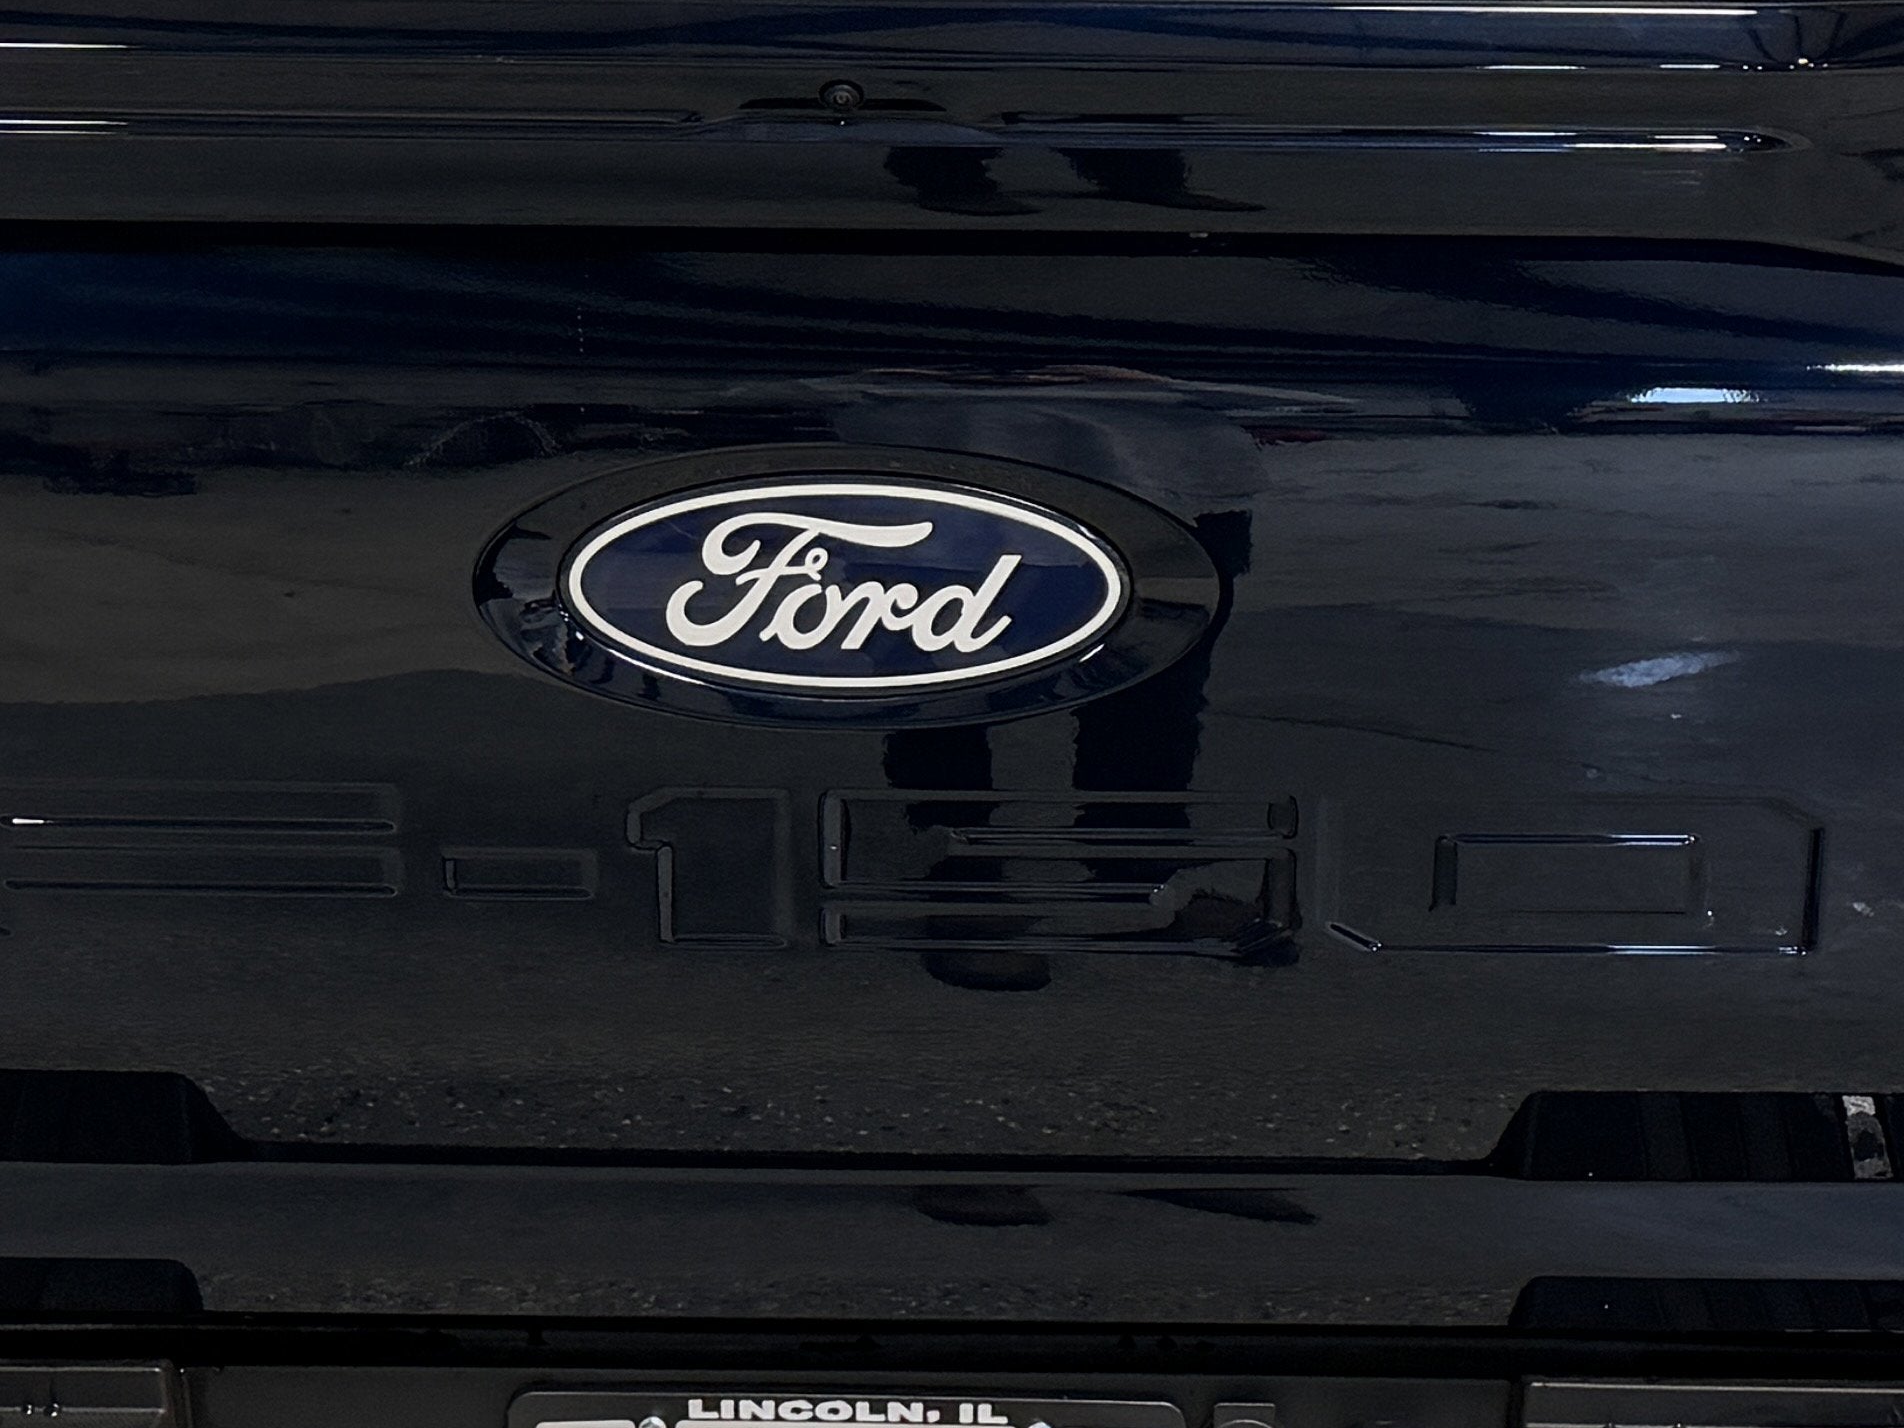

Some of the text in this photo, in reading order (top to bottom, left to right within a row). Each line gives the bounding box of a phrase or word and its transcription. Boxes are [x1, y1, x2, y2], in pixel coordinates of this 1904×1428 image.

[665, 512, 1022, 654] Ford
[687, 1398, 1009, 1425] LINCOLN, IL
